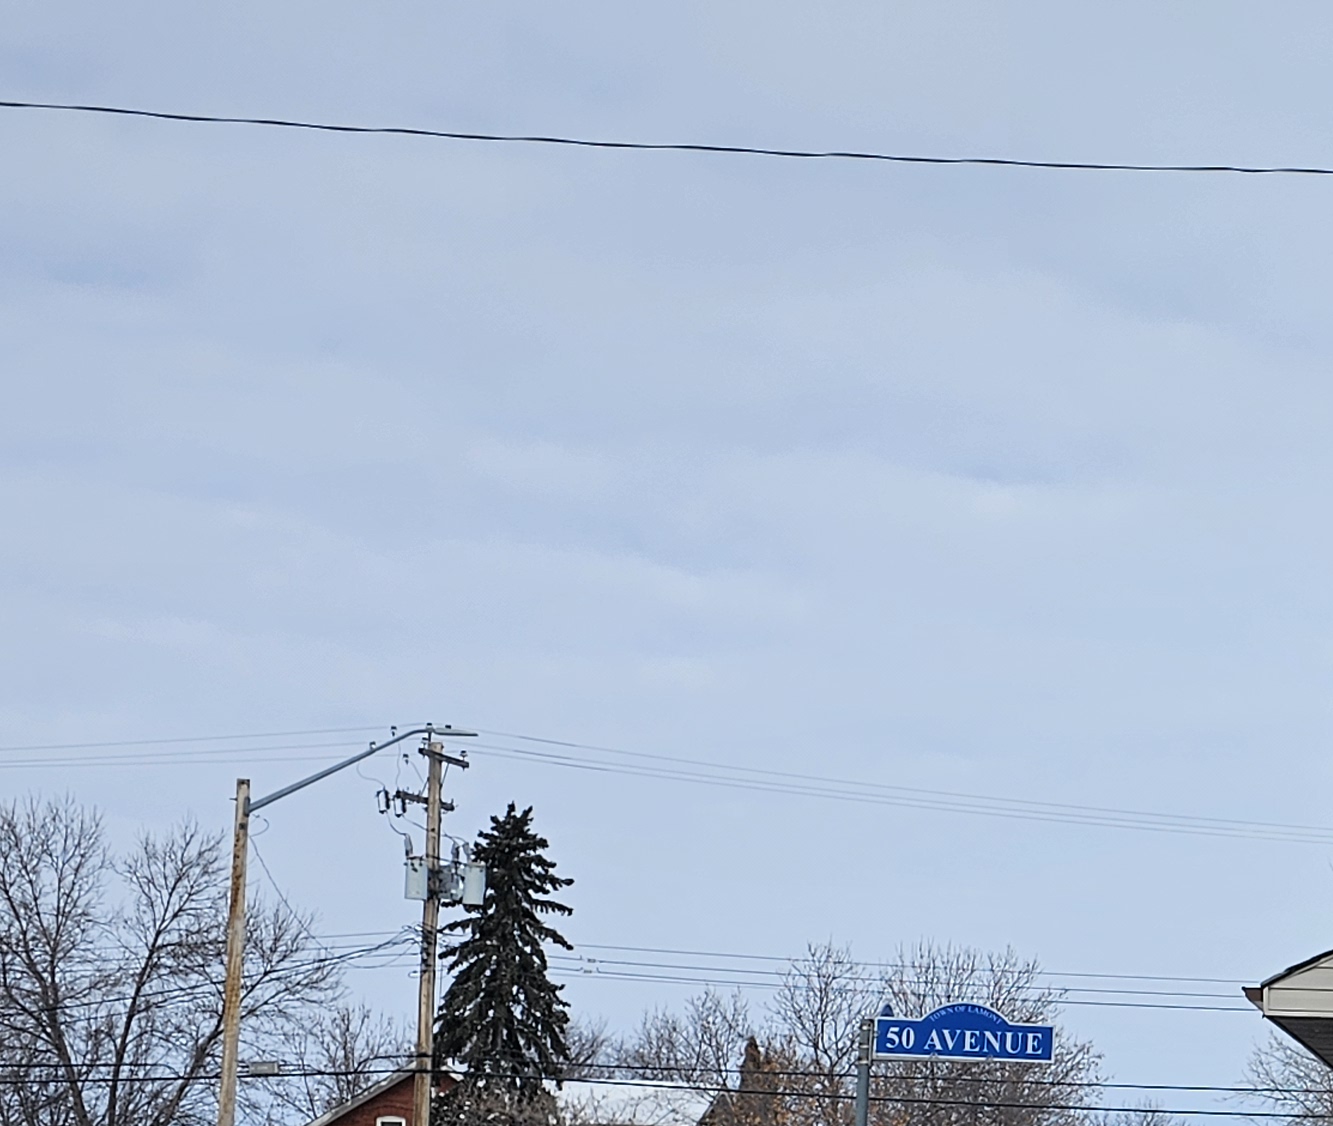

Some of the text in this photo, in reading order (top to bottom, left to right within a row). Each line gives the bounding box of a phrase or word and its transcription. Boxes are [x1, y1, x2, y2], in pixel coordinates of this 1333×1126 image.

[929, 1005, 1002, 1024] TOWN OF LAMONT
[885, 1026, 1043, 1055] 50 AVENUE
